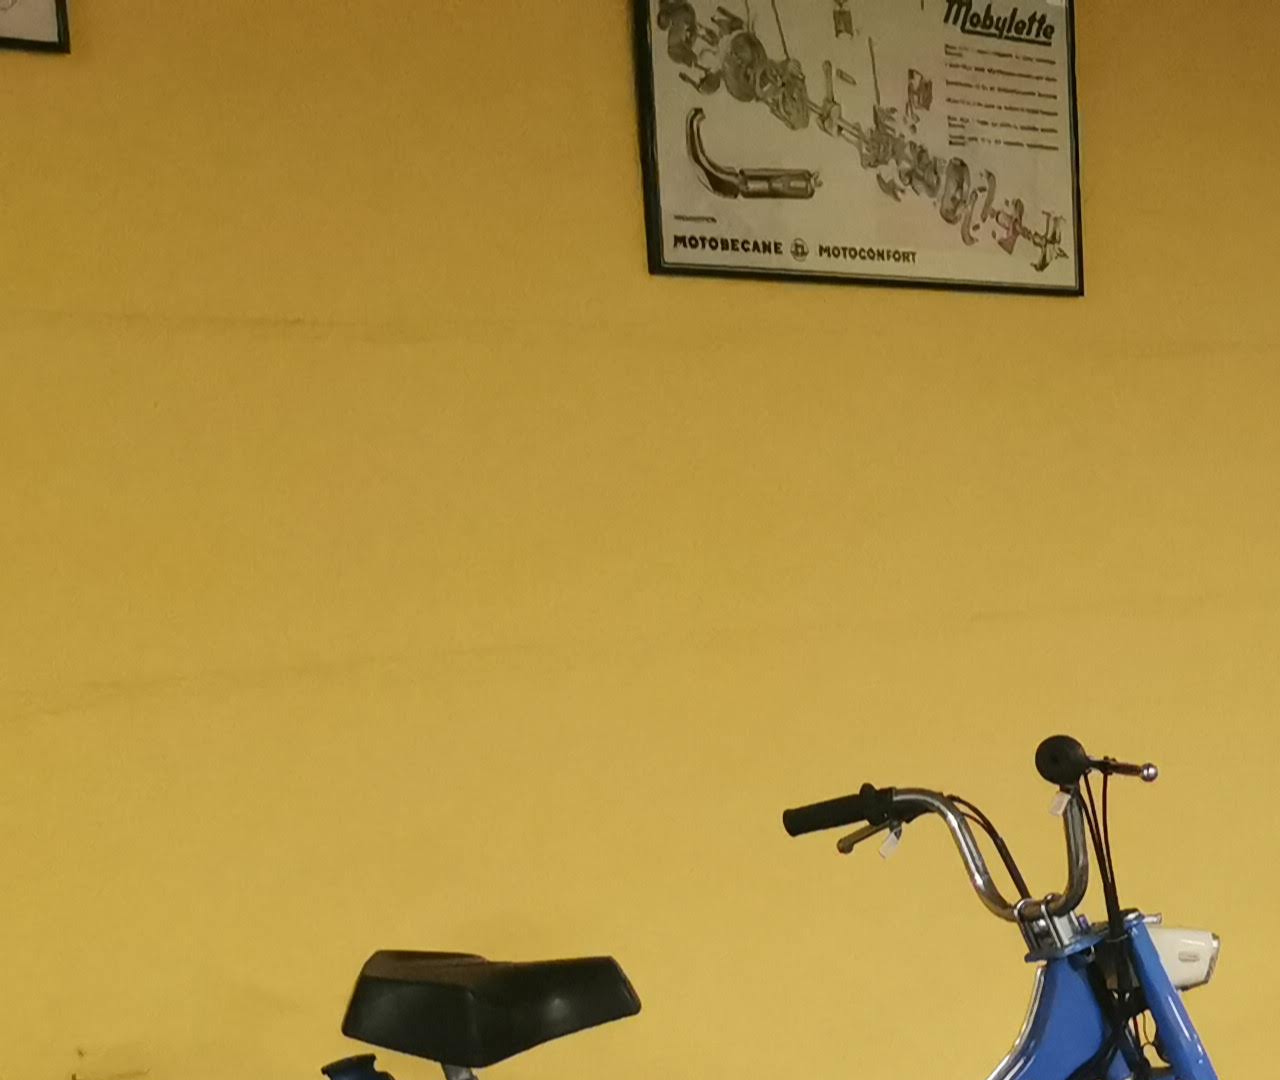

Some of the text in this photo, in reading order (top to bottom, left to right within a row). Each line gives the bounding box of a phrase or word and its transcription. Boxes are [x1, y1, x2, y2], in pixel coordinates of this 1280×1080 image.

[944, 0, 1055, 42] Mobylette
[673, 235, 917, 264] MOTOBECANE MOTOCONFORT
